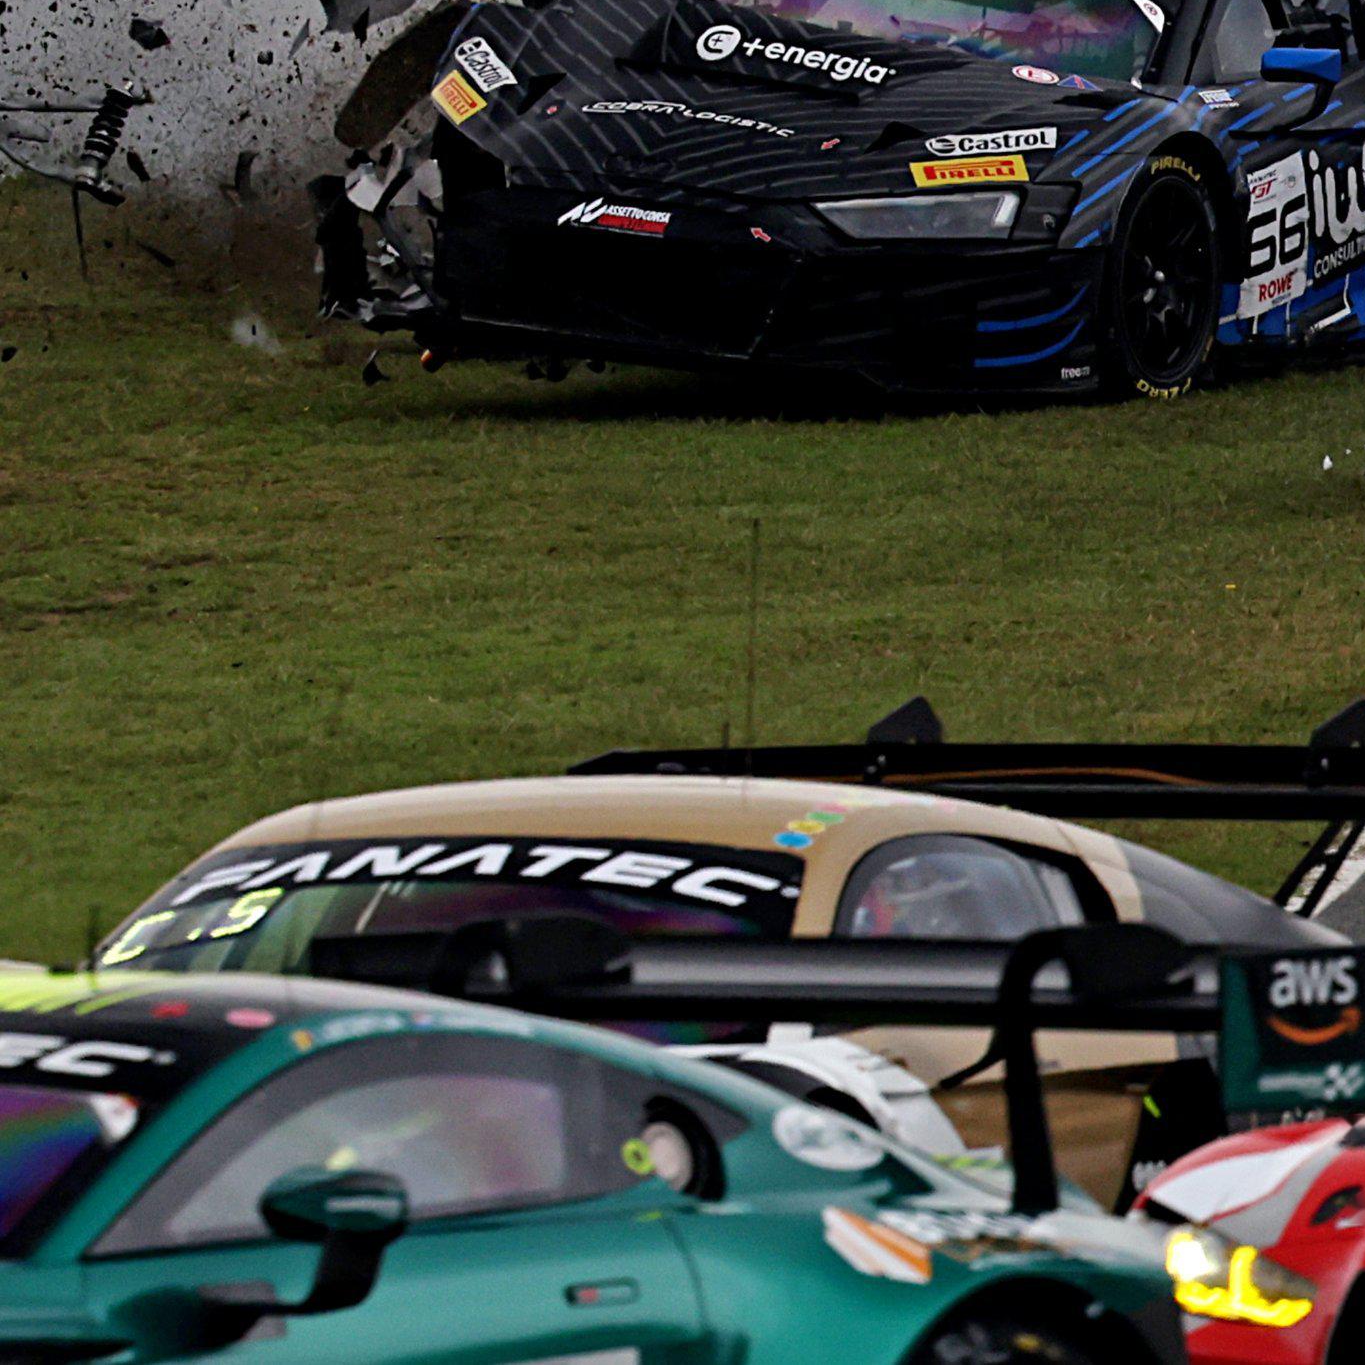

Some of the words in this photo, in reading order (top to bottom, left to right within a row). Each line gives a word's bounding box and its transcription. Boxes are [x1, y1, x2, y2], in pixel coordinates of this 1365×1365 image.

[464, 50, 510, 88] Castrol
[583, 99, 686, 115] COBRA
[683, 108, 795, 138] LOGISTIC
[958, 130, 1051, 153] Castrol
[923, 160, 1016, 181] PIRELLI
[1151, 155, 1201, 182] PIRELLI
[1247, 183, 1307, 280] 56
[1259, 268, 1298, 302] ROWE
[172, 843, 779, 906] FANATEC
[1268, 958, 1358, 1006] aws
